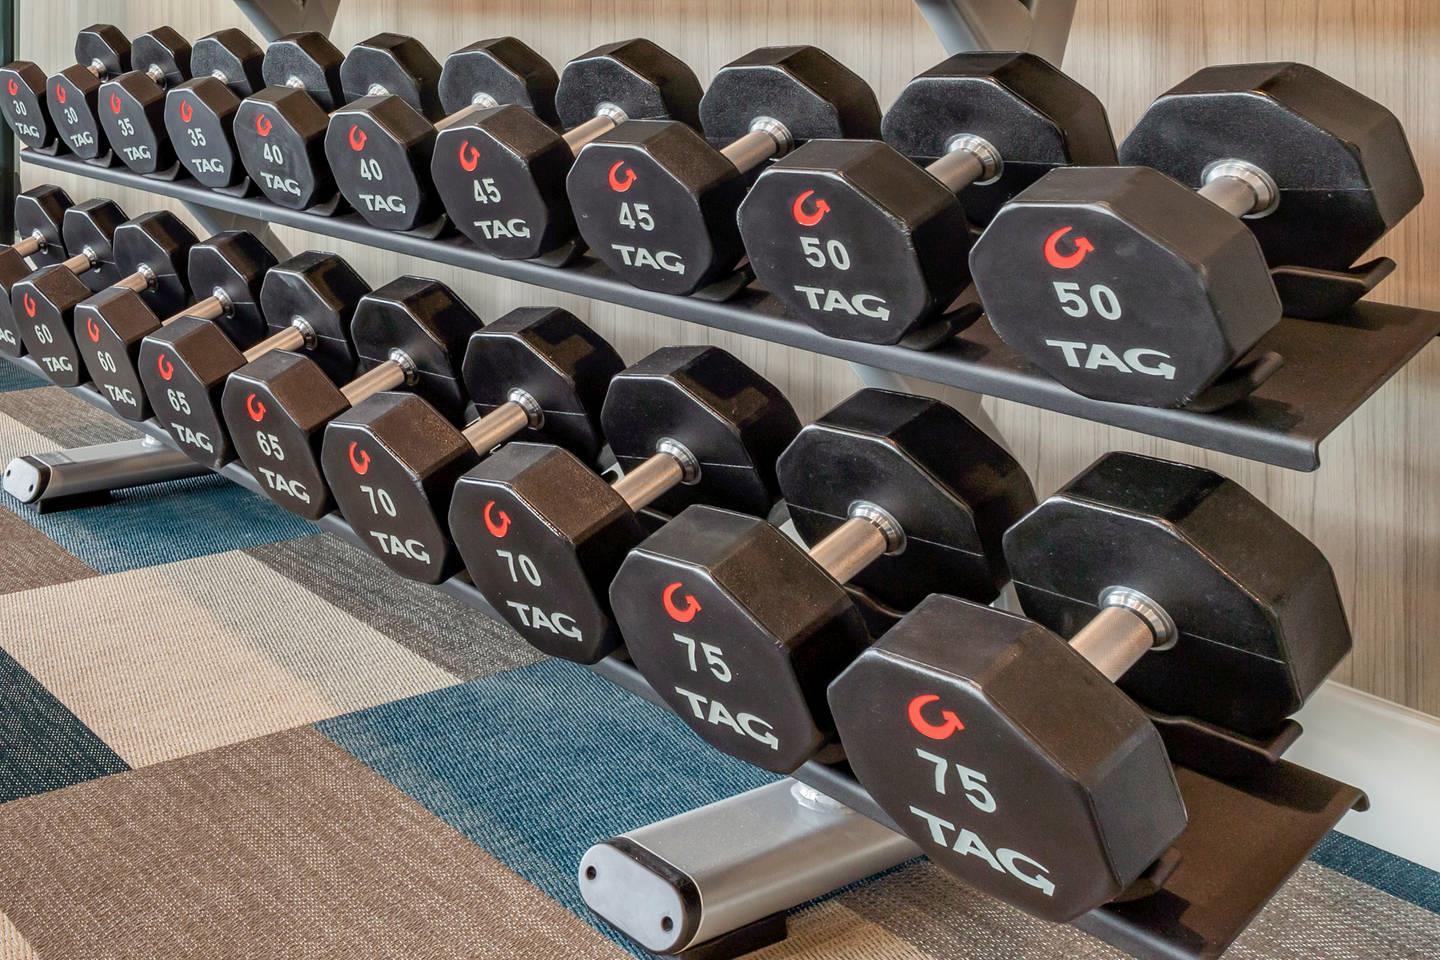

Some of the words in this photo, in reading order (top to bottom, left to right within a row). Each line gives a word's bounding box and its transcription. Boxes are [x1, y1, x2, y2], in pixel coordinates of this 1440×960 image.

[13, 100, 28, 116] 30
[64, 107, 77, 124] 30
[15, 122, 40, 138] TAG
[70, 131, 94, 148] TAG
[118, 118, 134, 137] 35
[187, 128, 206, 147] 35
[123, 145, 151, 161] TAG
[191, 158, 224, 173] TAG
[263, 143, 283, 165] 40
[360, 159, 383, 181] 40
[260, 172, 301, 197] TAG
[473, 178, 502, 204] 45
[359, 194, 406, 214] TAG
[618, 202, 655, 231] 45
[474, 218, 530, 240] TAG
[611, 243, 685, 275] TAG
[799, 236, 850, 270] 50
[794, 285, 890, 321] TAG
[1053, 281, 1122, 320] 50
[34, 324, 53, 344] 60
[42, 356, 73, 372] TAG
[97, 351, 116, 373] 60
[1045, 339, 1176, 380] TAG
[104, 384, 137, 406] TAG
[167, 388, 191, 415] 65
[171, 423, 213, 453] TAG
[256, 431, 285, 461] 65
[258, 467, 310, 504] TAG
[360, 486, 396, 517] 70
[370, 531, 430, 564] TAG
[496, 549, 541, 587] 70
[507, 600, 583, 642] TAG
[672, 633, 732, 683] 75
[675, 687, 779, 750] TAG
[916, 748, 997, 813] 75
[909, 805, 1056, 897] TAG
